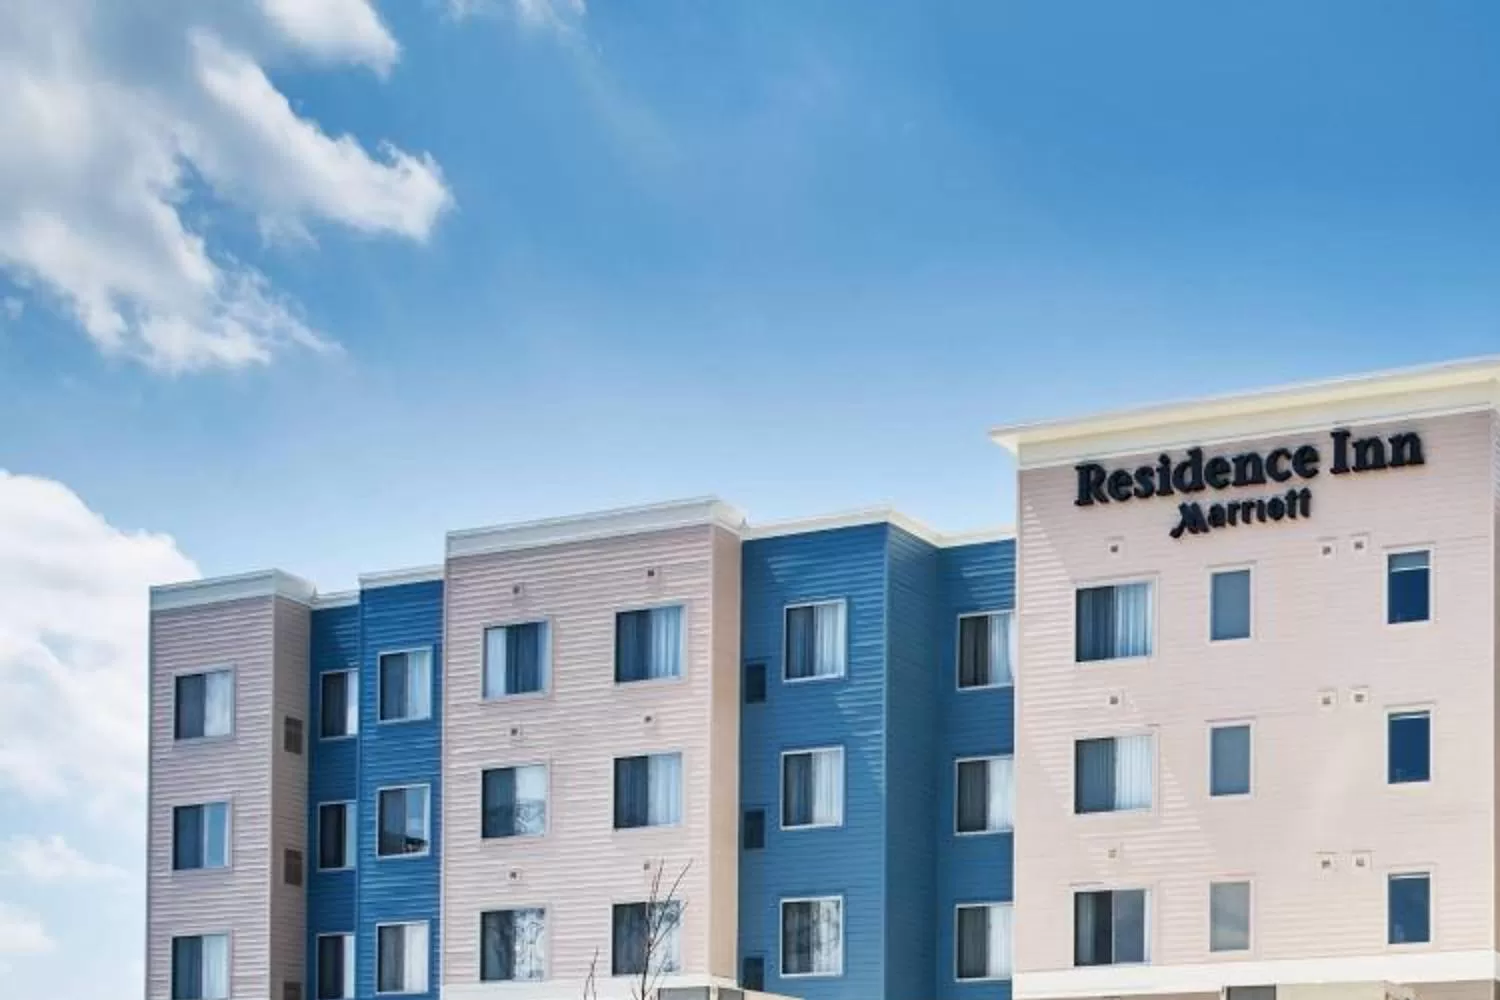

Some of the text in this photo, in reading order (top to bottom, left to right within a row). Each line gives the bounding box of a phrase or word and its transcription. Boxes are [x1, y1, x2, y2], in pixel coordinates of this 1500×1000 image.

[1074, 428, 1425, 507] Residence Inn
[1169, 487, 1312, 539] Marriott
